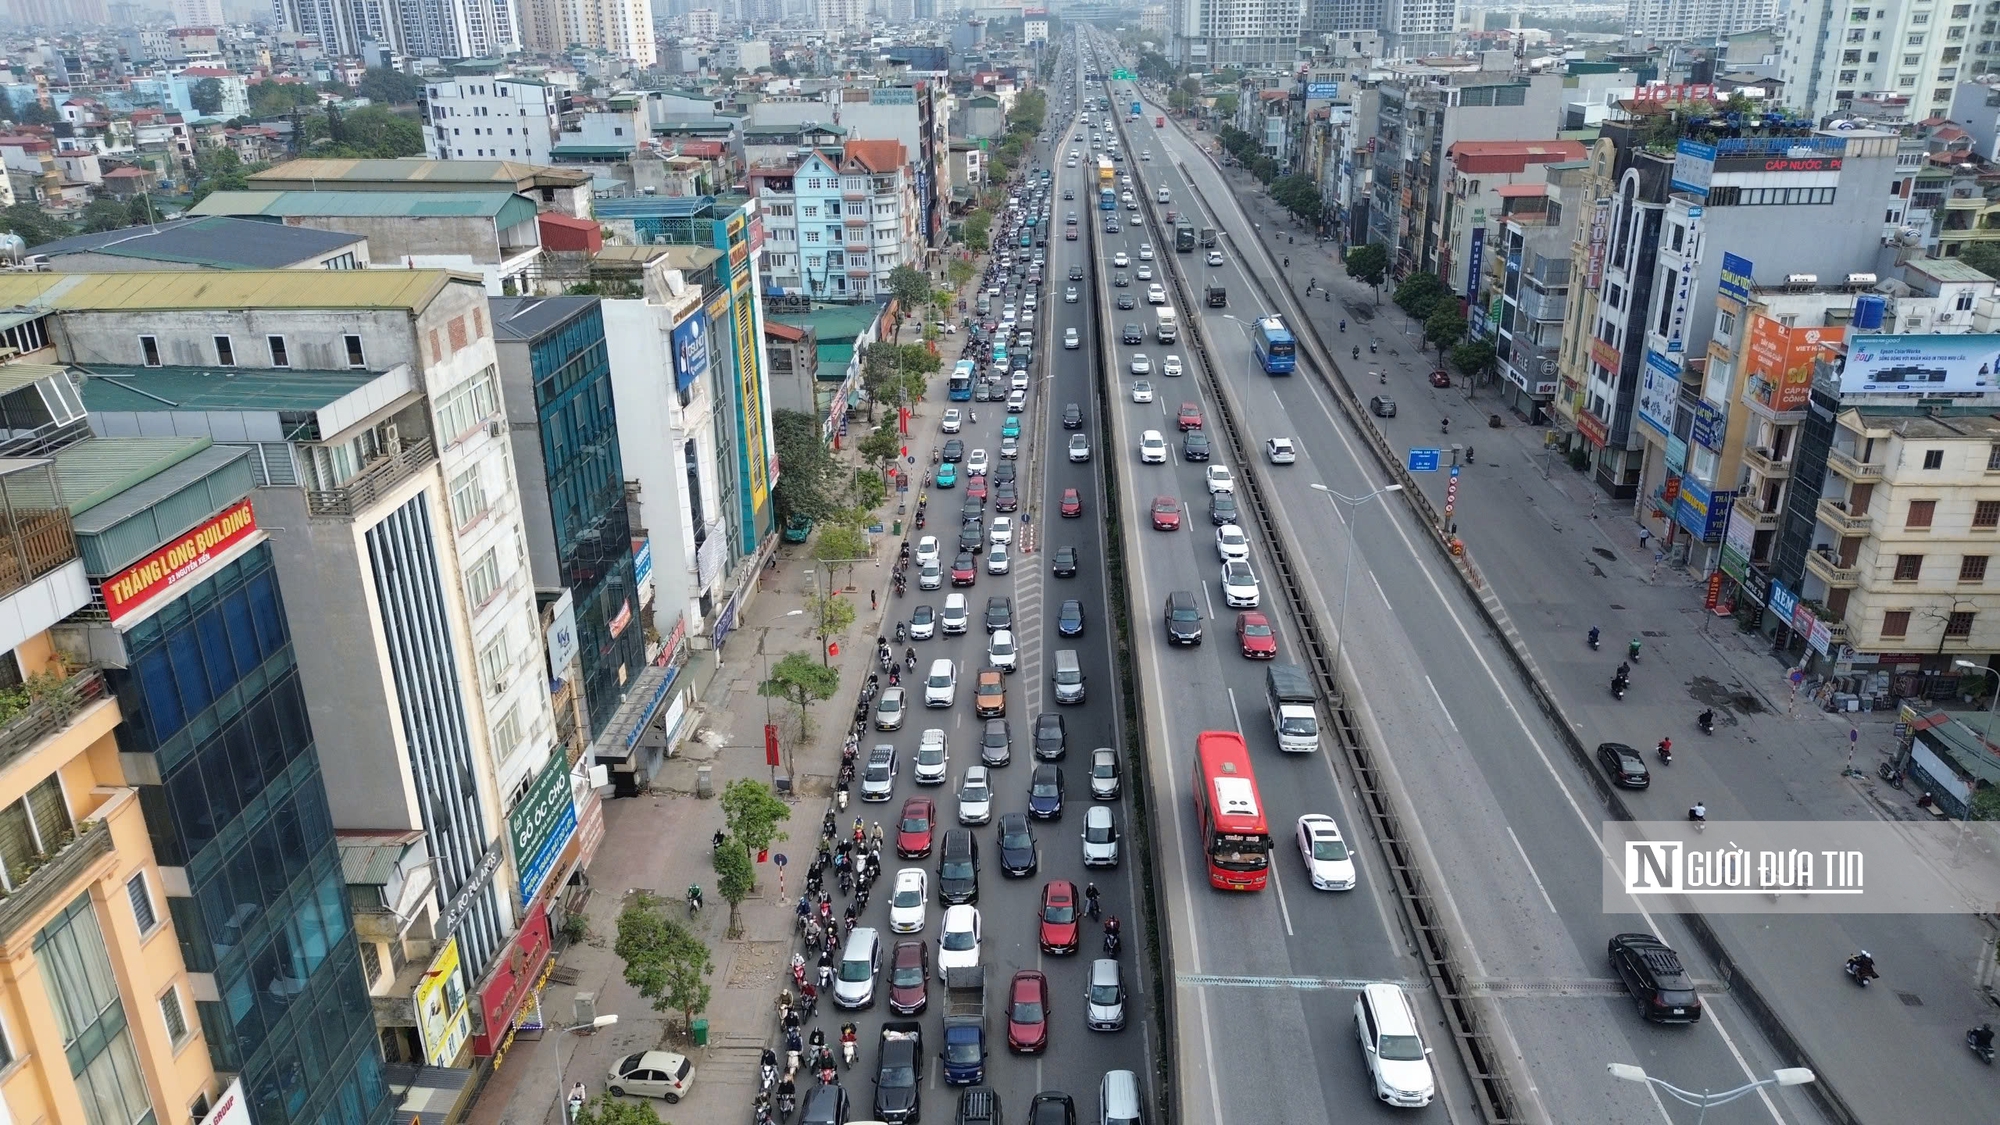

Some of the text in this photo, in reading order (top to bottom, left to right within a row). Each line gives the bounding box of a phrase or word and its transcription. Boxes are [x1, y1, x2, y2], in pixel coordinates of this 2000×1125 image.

[1633, 82, 1715, 105] HOTEL
[1765, 159, 1788, 170] CẤP
[1789, 159, 1822, 170] NƯỚC
[1587, 209, 1607, 288] HOTEL
[111, 506, 252, 605] THĂNG LONG BUILDING
[167, 574, 176, 585] 23
[520, 816, 534, 848] GỖ
[548, 773, 566, 805] CHÓ
[213, 1095, 235, 1125] GROUP
